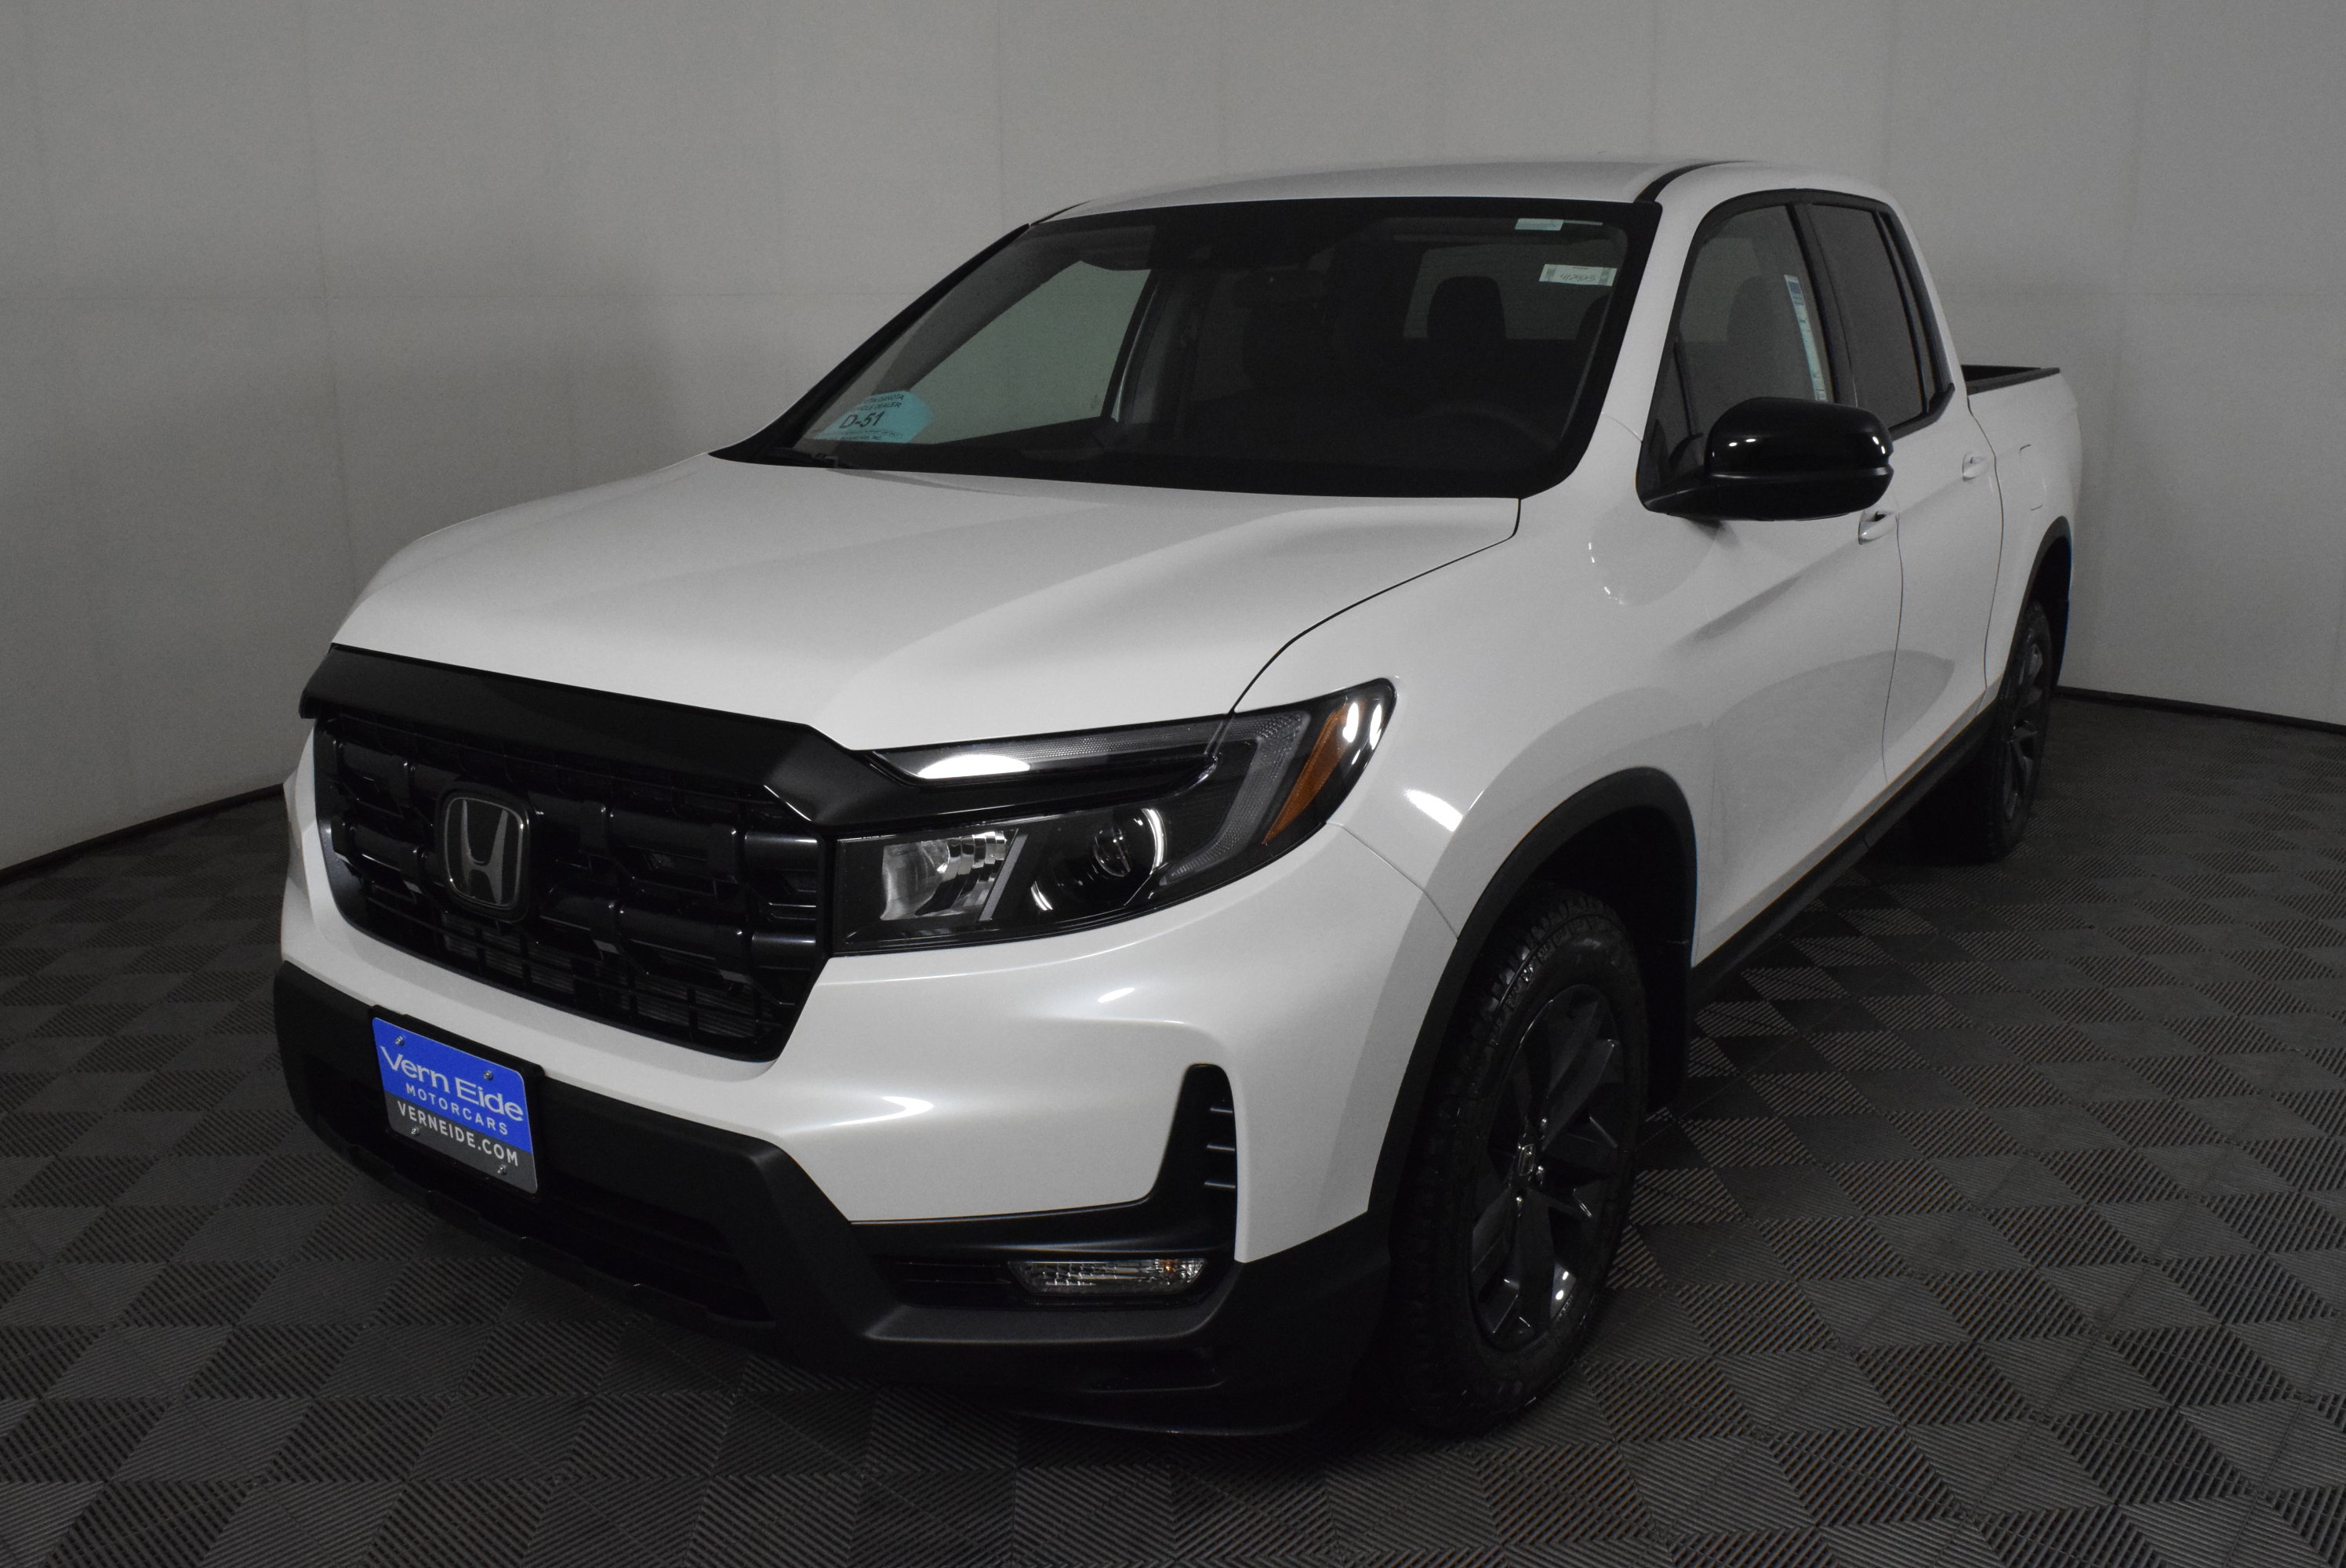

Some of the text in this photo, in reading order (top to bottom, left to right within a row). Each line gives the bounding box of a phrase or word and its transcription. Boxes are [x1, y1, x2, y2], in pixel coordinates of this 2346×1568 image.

[839, 411, 885, 429] D-51
[380, 1046, 524, 1122] Vern Eide
[405, 1083, 508, 1135] MOTORCARS
[397, 1101, 518, 1167] VERNEIDE.COM
